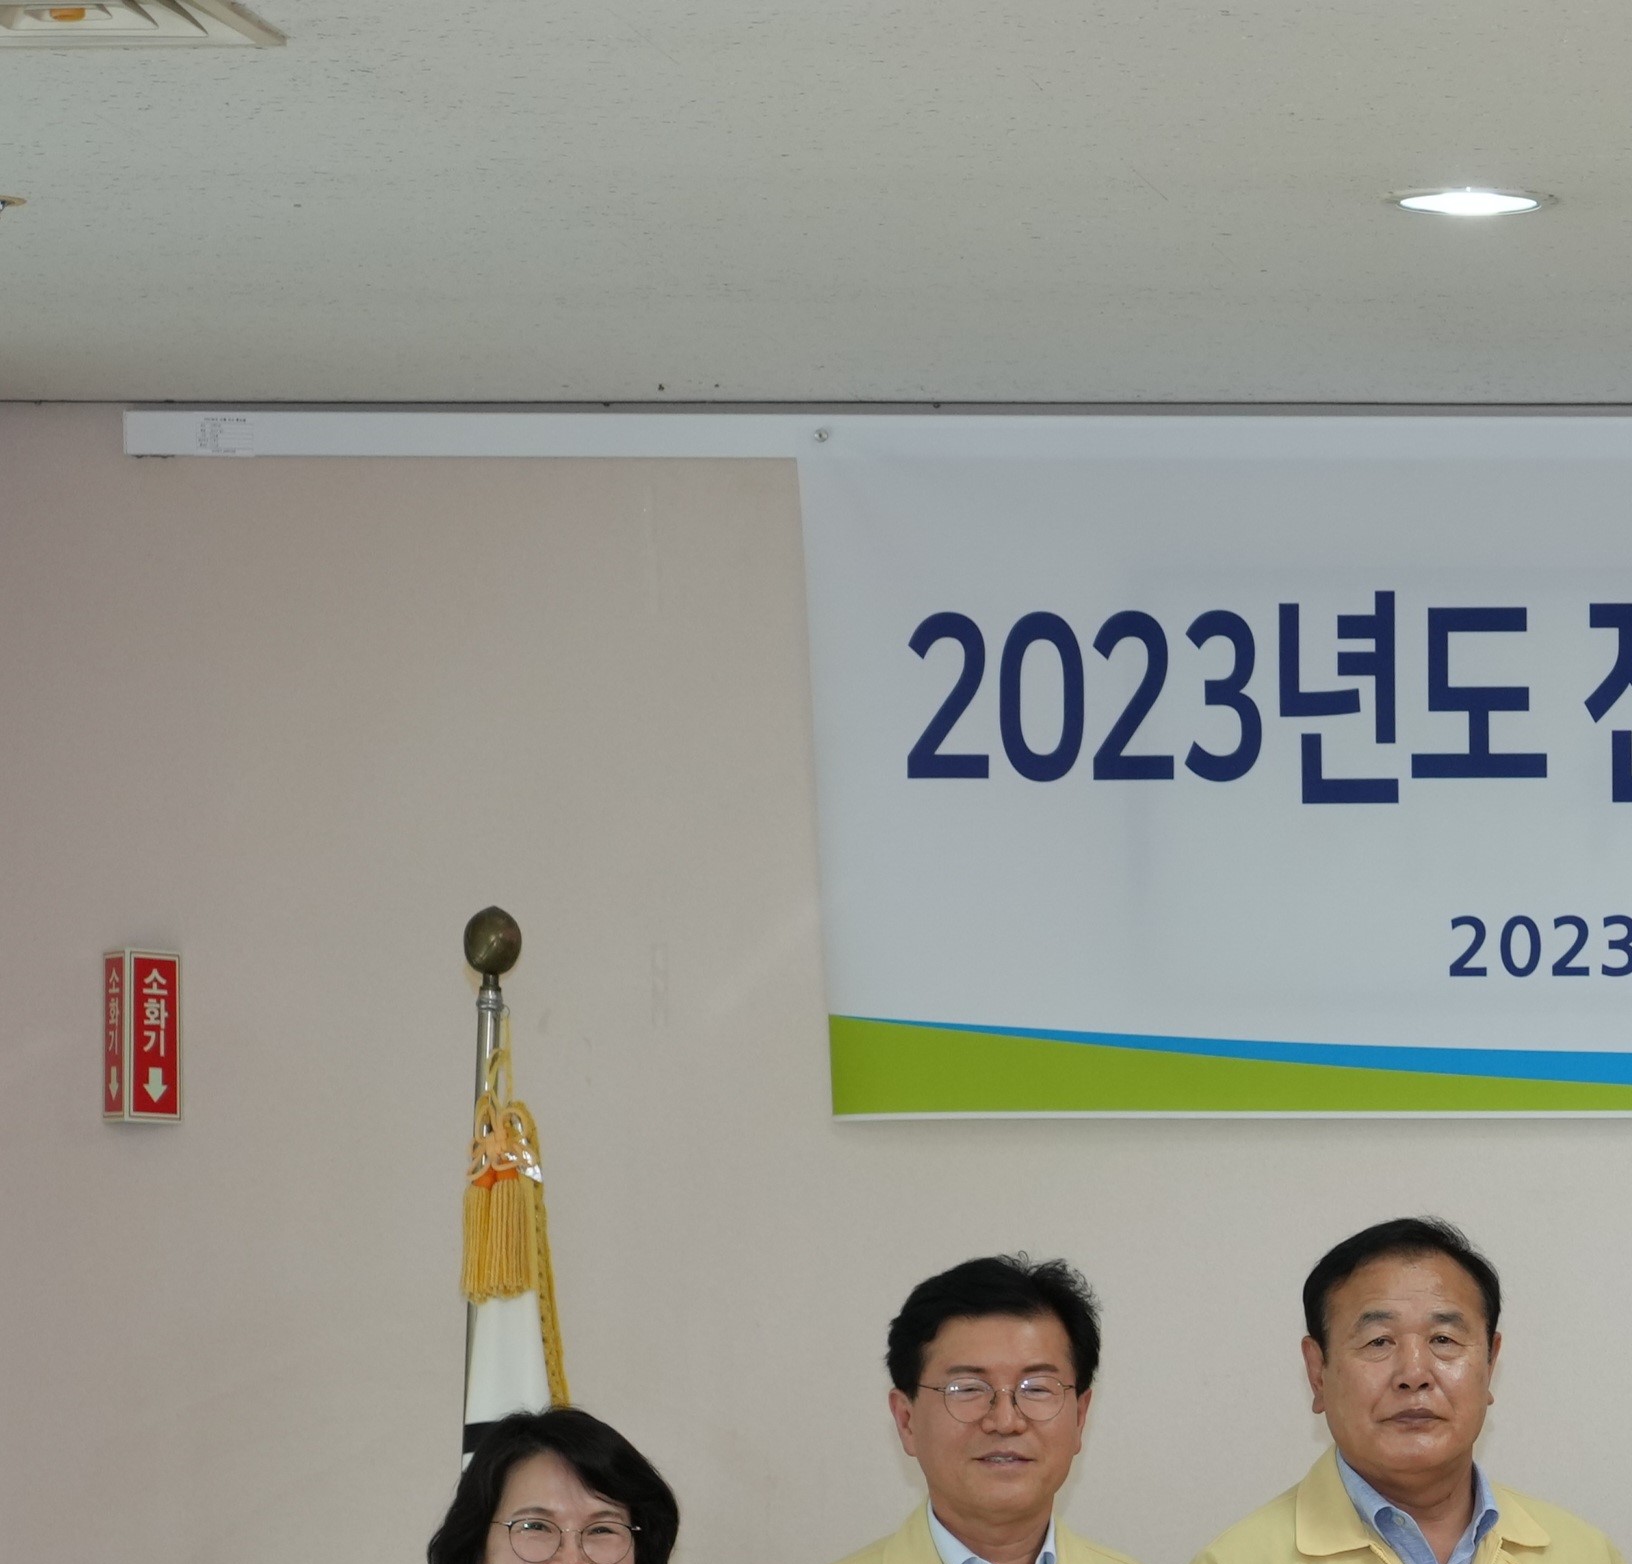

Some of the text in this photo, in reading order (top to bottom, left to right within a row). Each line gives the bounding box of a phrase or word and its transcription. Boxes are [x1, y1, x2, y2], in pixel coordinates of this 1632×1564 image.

[907, 591, 1548, 805] 2023년도
[108, 967, 120, 1056] 소화기
[142, 968, 169, 1058] 소화기
